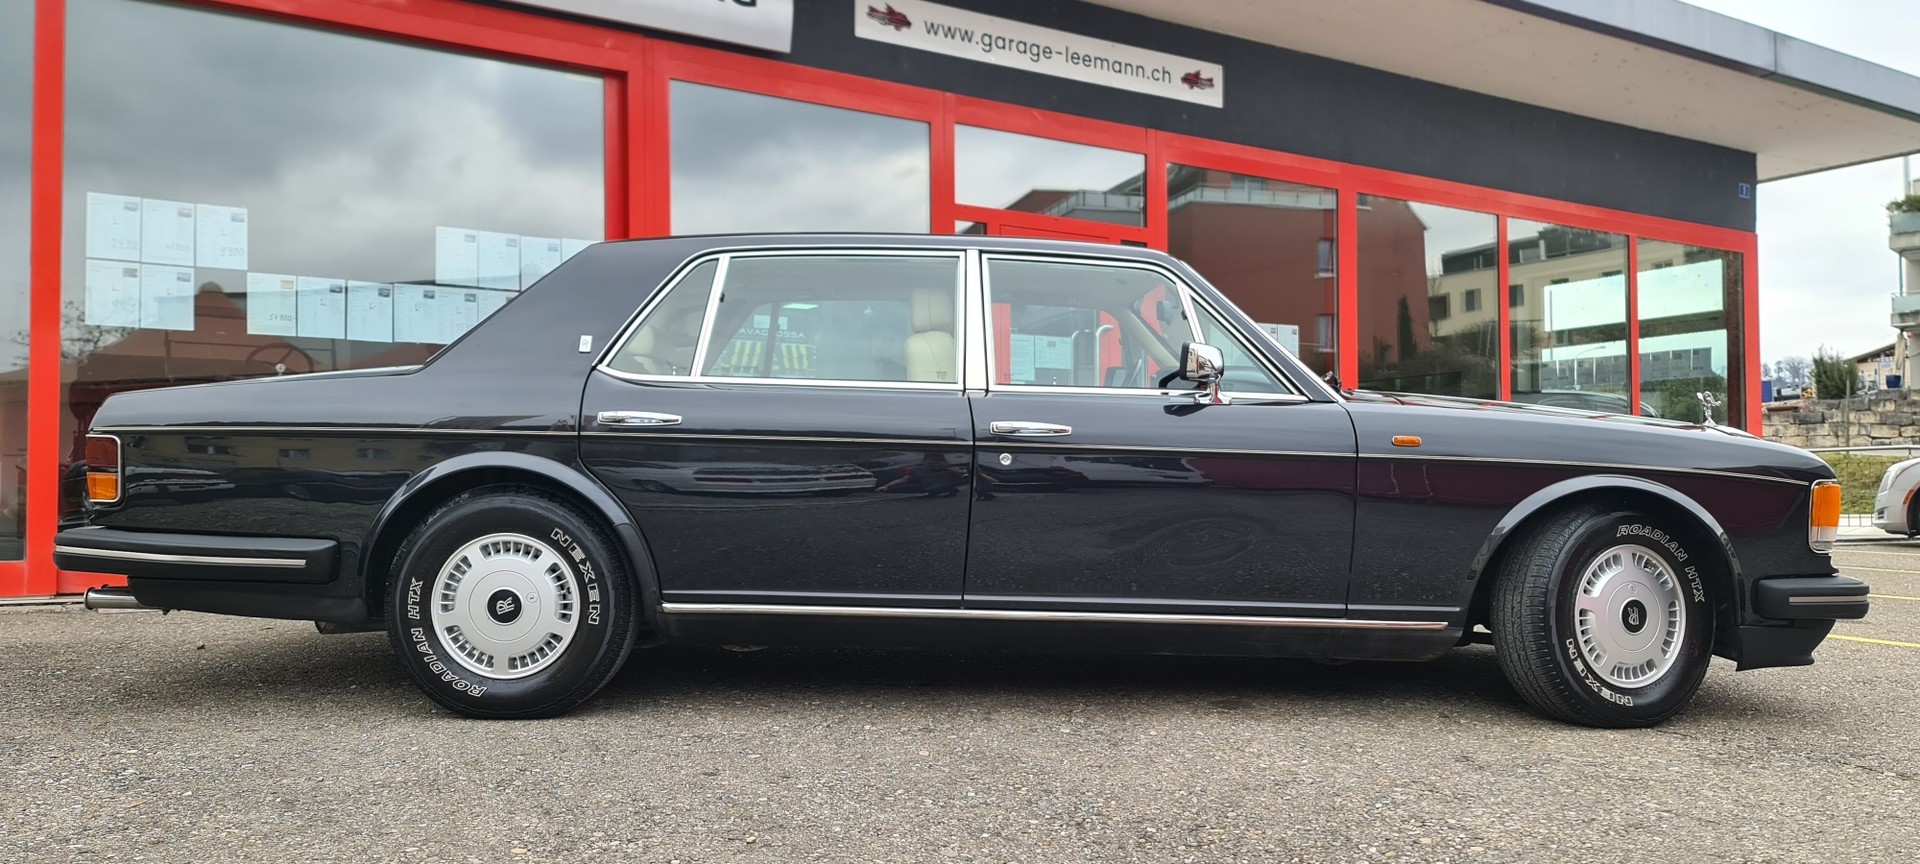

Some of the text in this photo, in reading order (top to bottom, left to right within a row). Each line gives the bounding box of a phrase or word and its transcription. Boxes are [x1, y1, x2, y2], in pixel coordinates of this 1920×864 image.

[923, 20, 1172, 84] www.garage-leemann.ch
[551, 528, 600, 625] NEXEN
[1616, 524, 1706, 603] ROADIAN HTX
[407, 577, 488, 698] ROADIAN HTX
[1566, 638, 1634, 707] NEXEN
